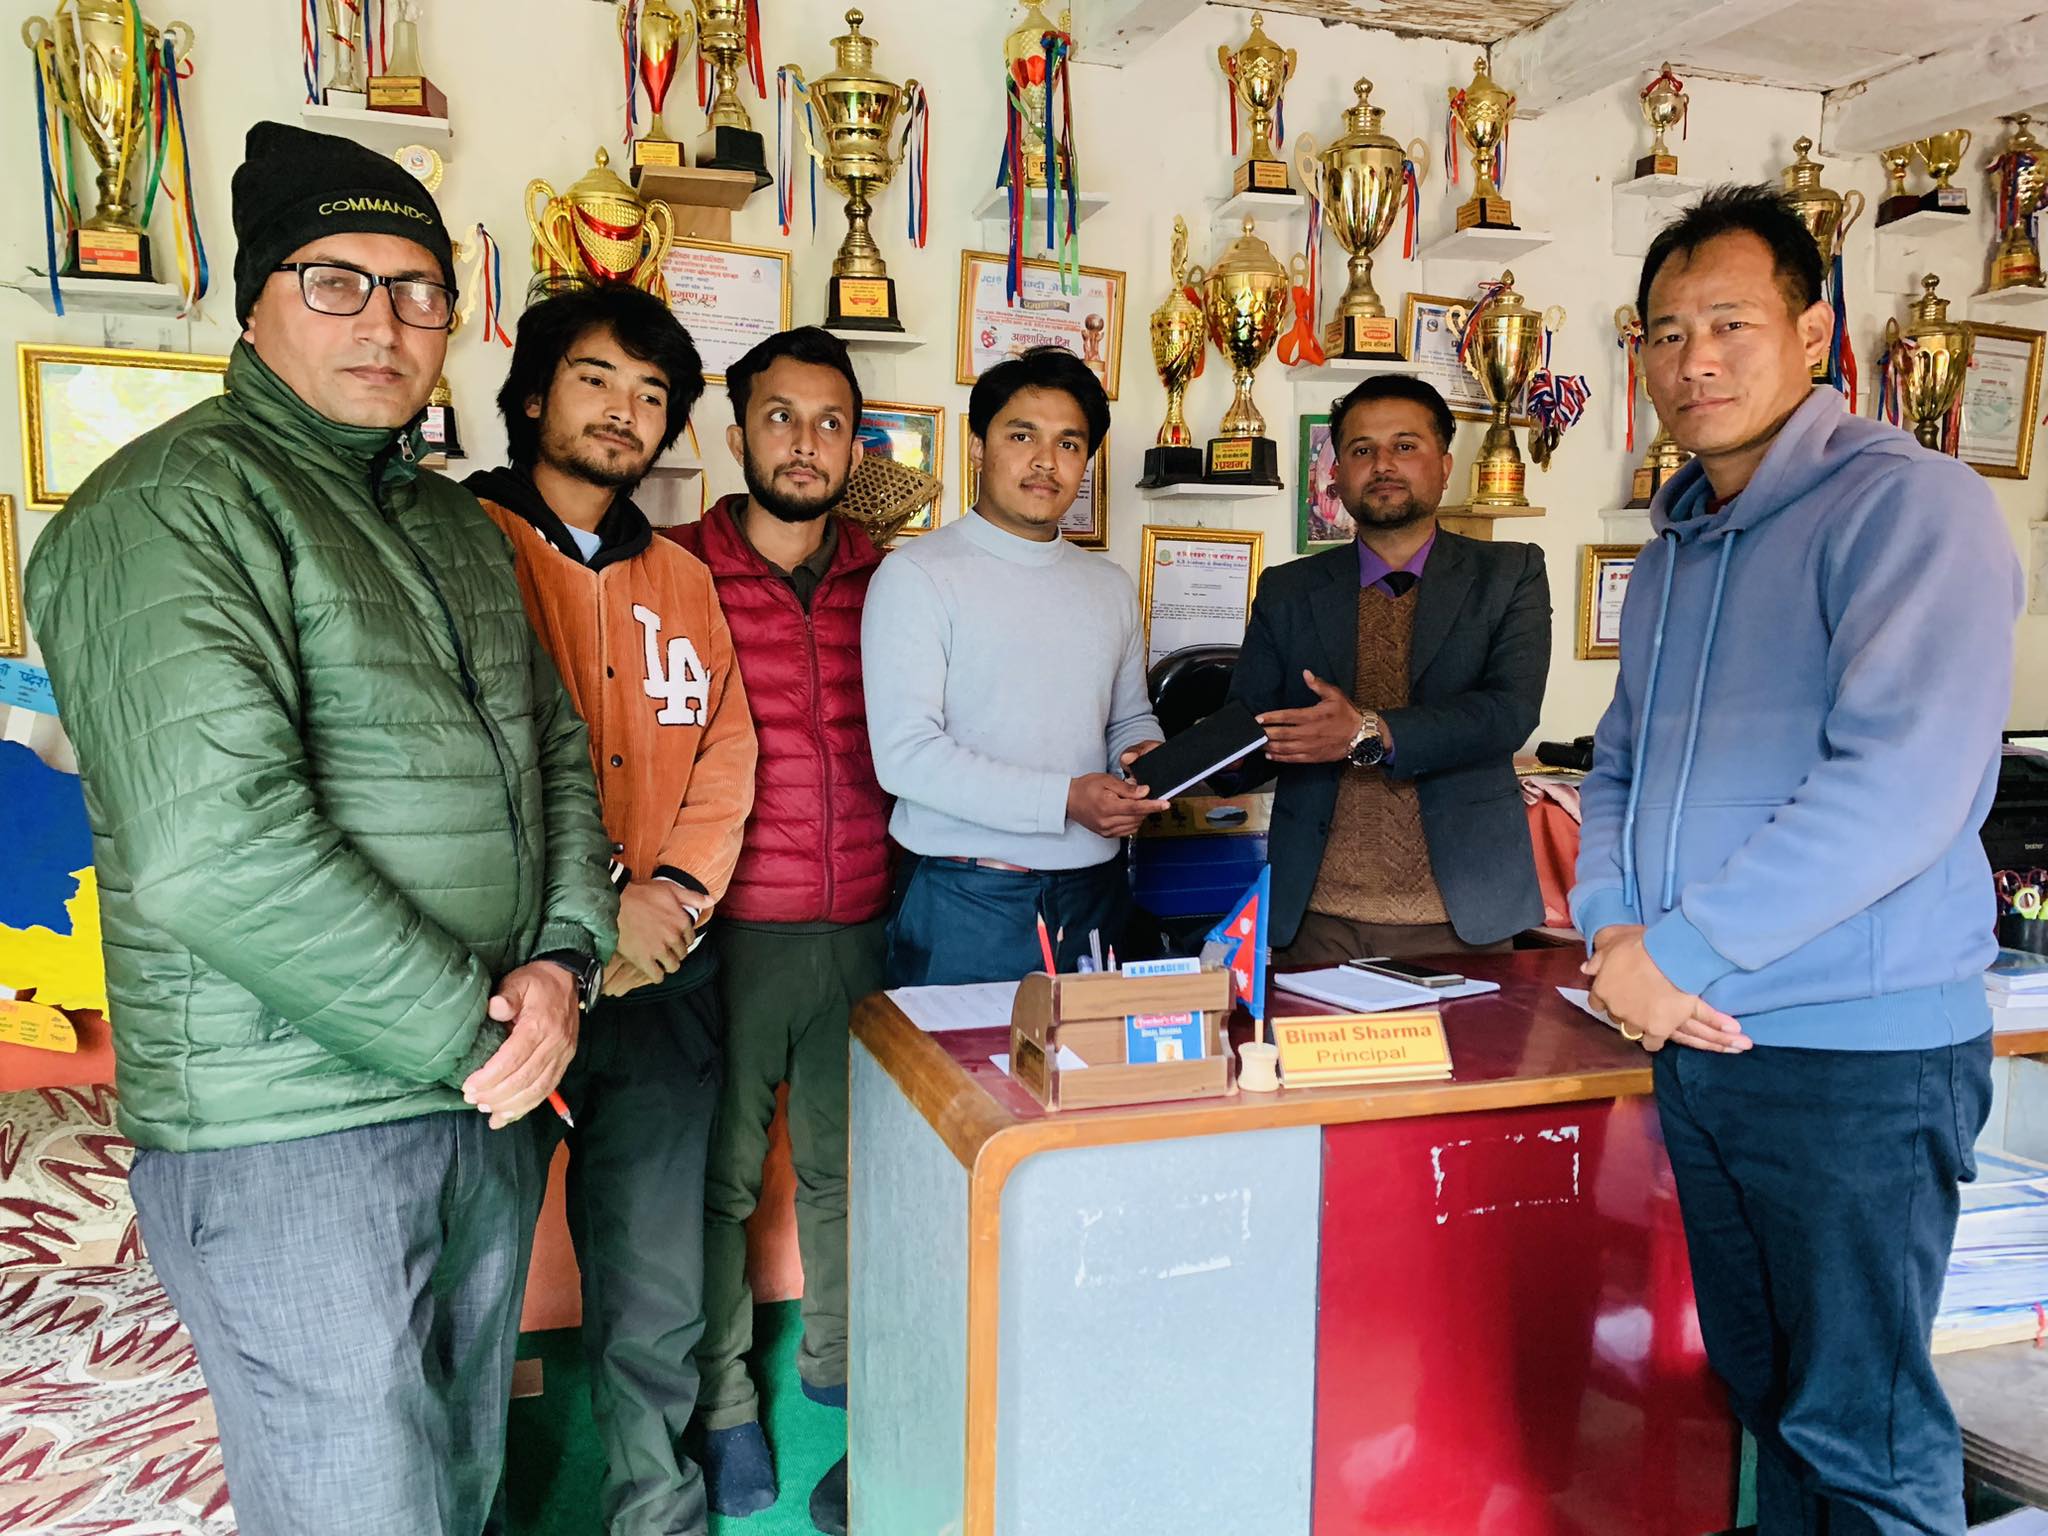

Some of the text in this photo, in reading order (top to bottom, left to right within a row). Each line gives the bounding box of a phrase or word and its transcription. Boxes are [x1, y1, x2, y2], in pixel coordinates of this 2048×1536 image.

[318, 197, 433, 225] COMMANDO
[632, 602, 711, 727] LA
[1285, 1025, 1433, 1045] Bimal Sharma
[1316, 1045, 1407, 1064] Principal
